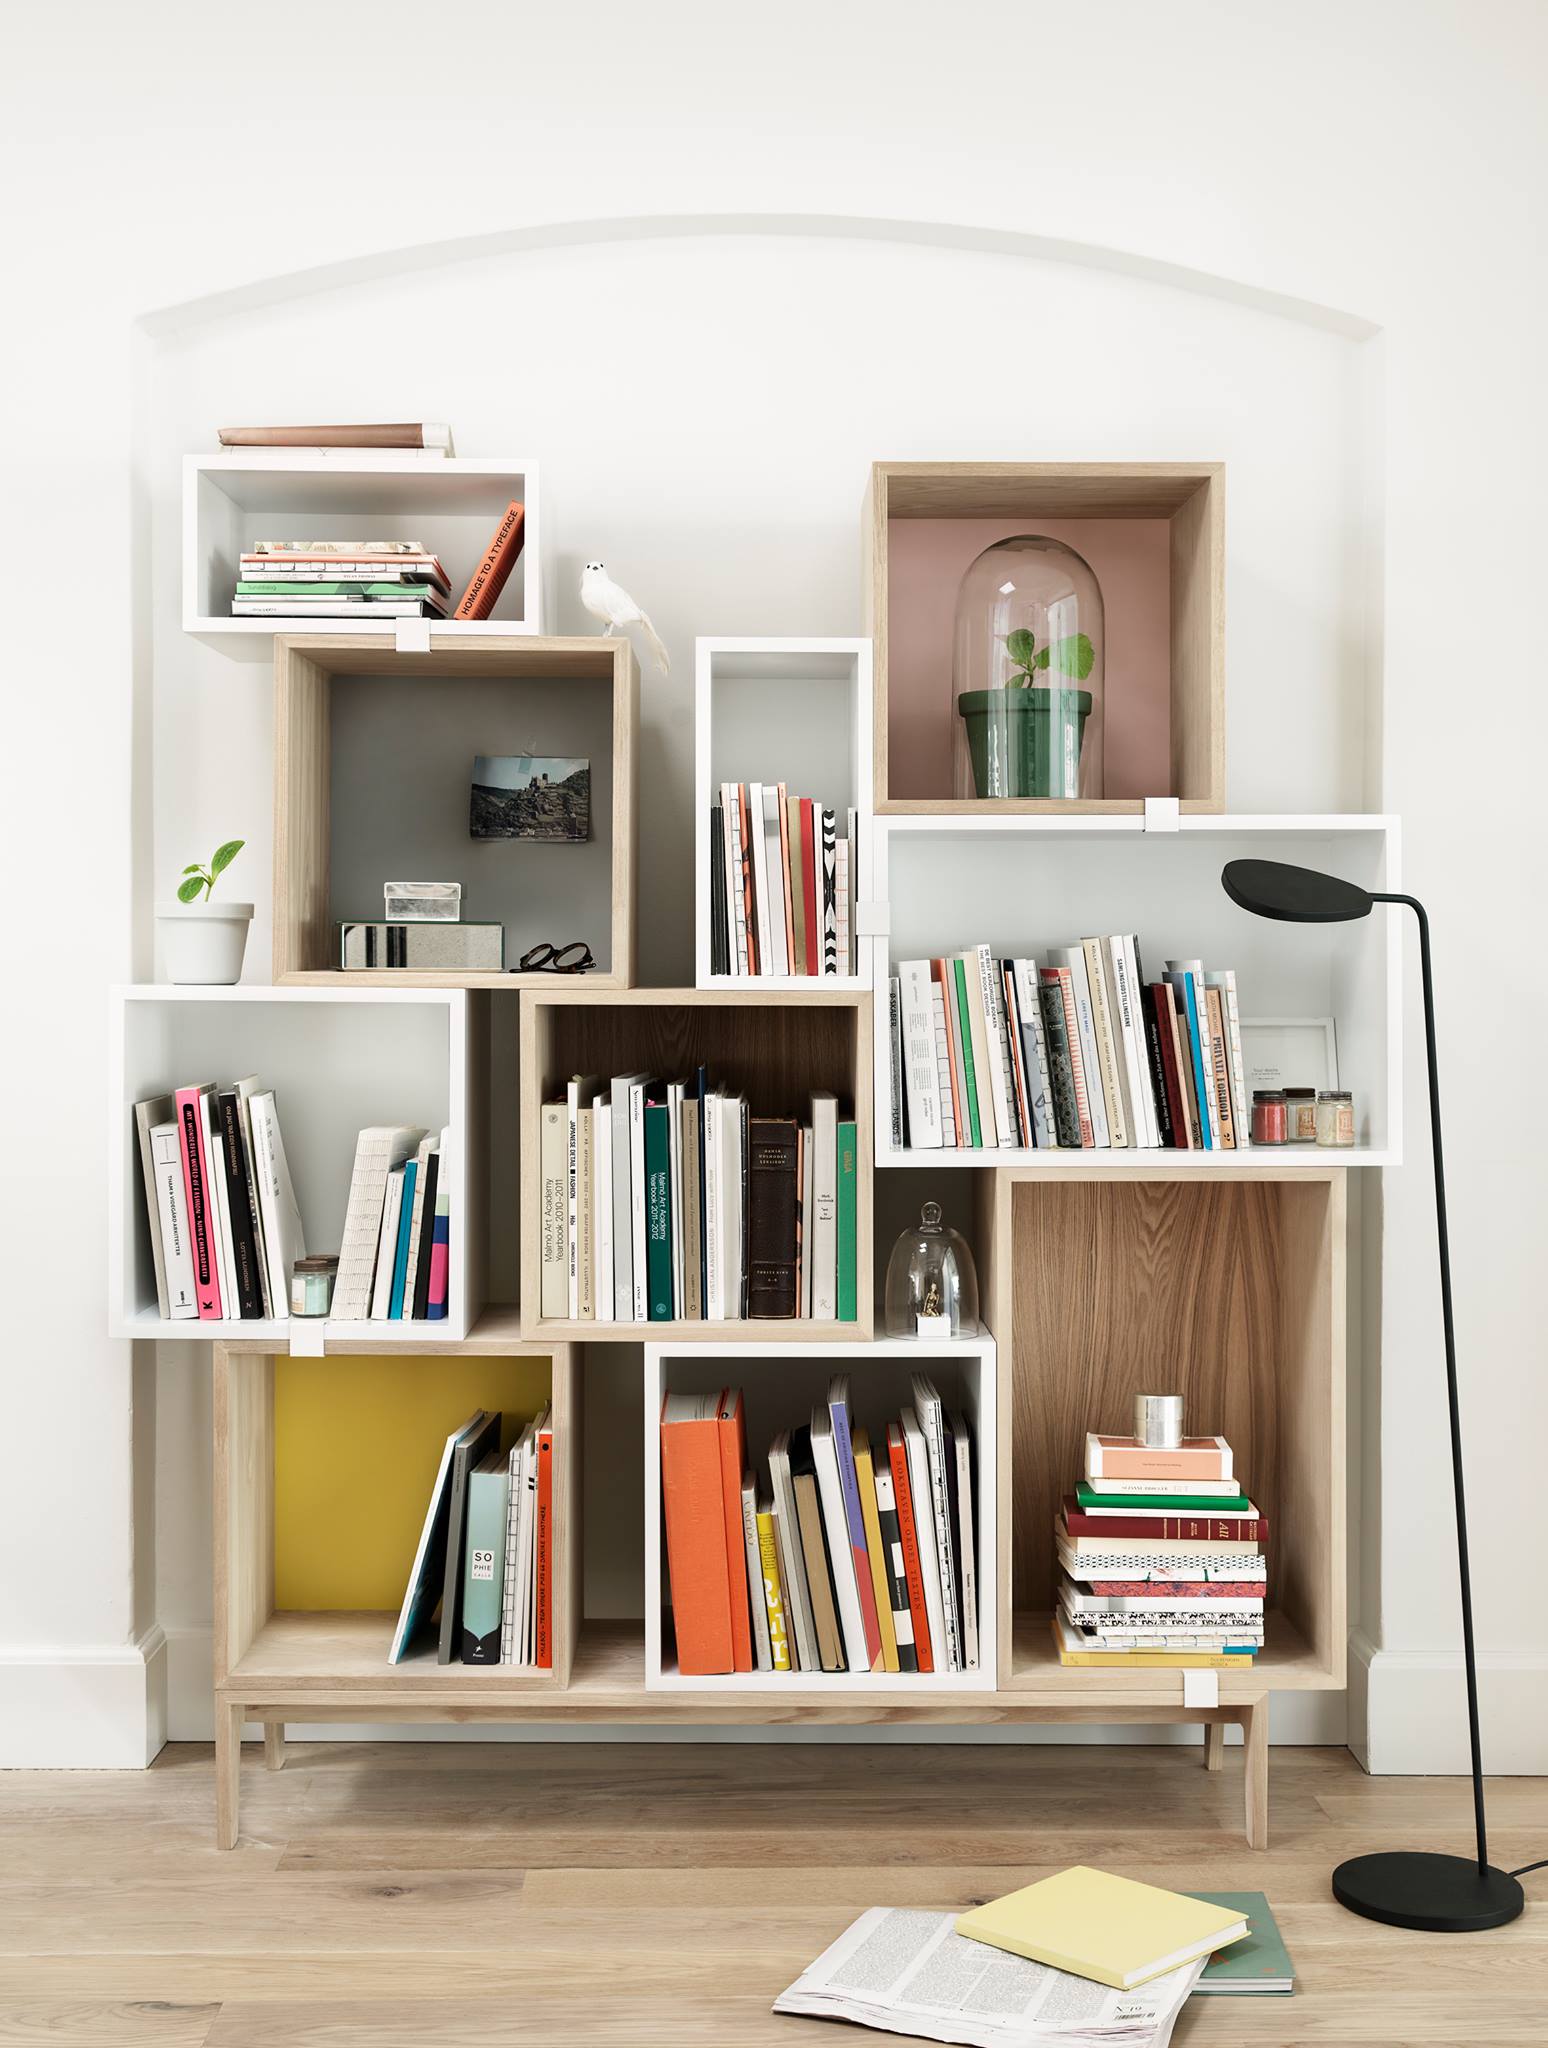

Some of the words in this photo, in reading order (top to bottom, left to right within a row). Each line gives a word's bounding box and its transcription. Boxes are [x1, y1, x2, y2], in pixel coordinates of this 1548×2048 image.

[461, 576, 486, 615] HOMAGE
[480, 563, 492, 576] TO
[491, 509, 518, 554] TYPEFACE
[984, 949, 990, 957] DE
[1117, 958, 1131, 1028] SAMLINGSUDSTILLINGERNE
[1209, 995, 1217, 1012] JUDITH
[1213, 1036, 1225, 1075] PRIVATE
[1217, 1077, 1229, 1121] FORHOLD
[187, 1111, 193, 1120] MY
[187, 1122, 197, 1157] WONDERFUL
[191, 1158, 199, 1178] WORLD
[194, 1187, 202, 1214] FASHION
[544, 1179, 554, 1217] Academy
[650, 1173, 658, 1204] Yearbook
[659, 1196, 667, 1207] Art
[172, 1223, 181, 1256] ARKITEKTER
[196, 1220, 204, 1236] NINA
[544, 1218, 553, 1232] Art
[658, 1209, 667, 1241] Academy
[555, 1224, 564, 1262] Yearbook
[241, 1261, 250, 1291] LUNDGREN
[203, 1301, 213, 1310] K
[896, 1460, 910, 1522] BOKSTAVEN
[904, 1529, 914, 1563] ORDET
[910, 1569, 921, 1610] TEXTEN
[1219, 1521, 1229, 1538] All
[474, 1552, 492, 1562] SO
